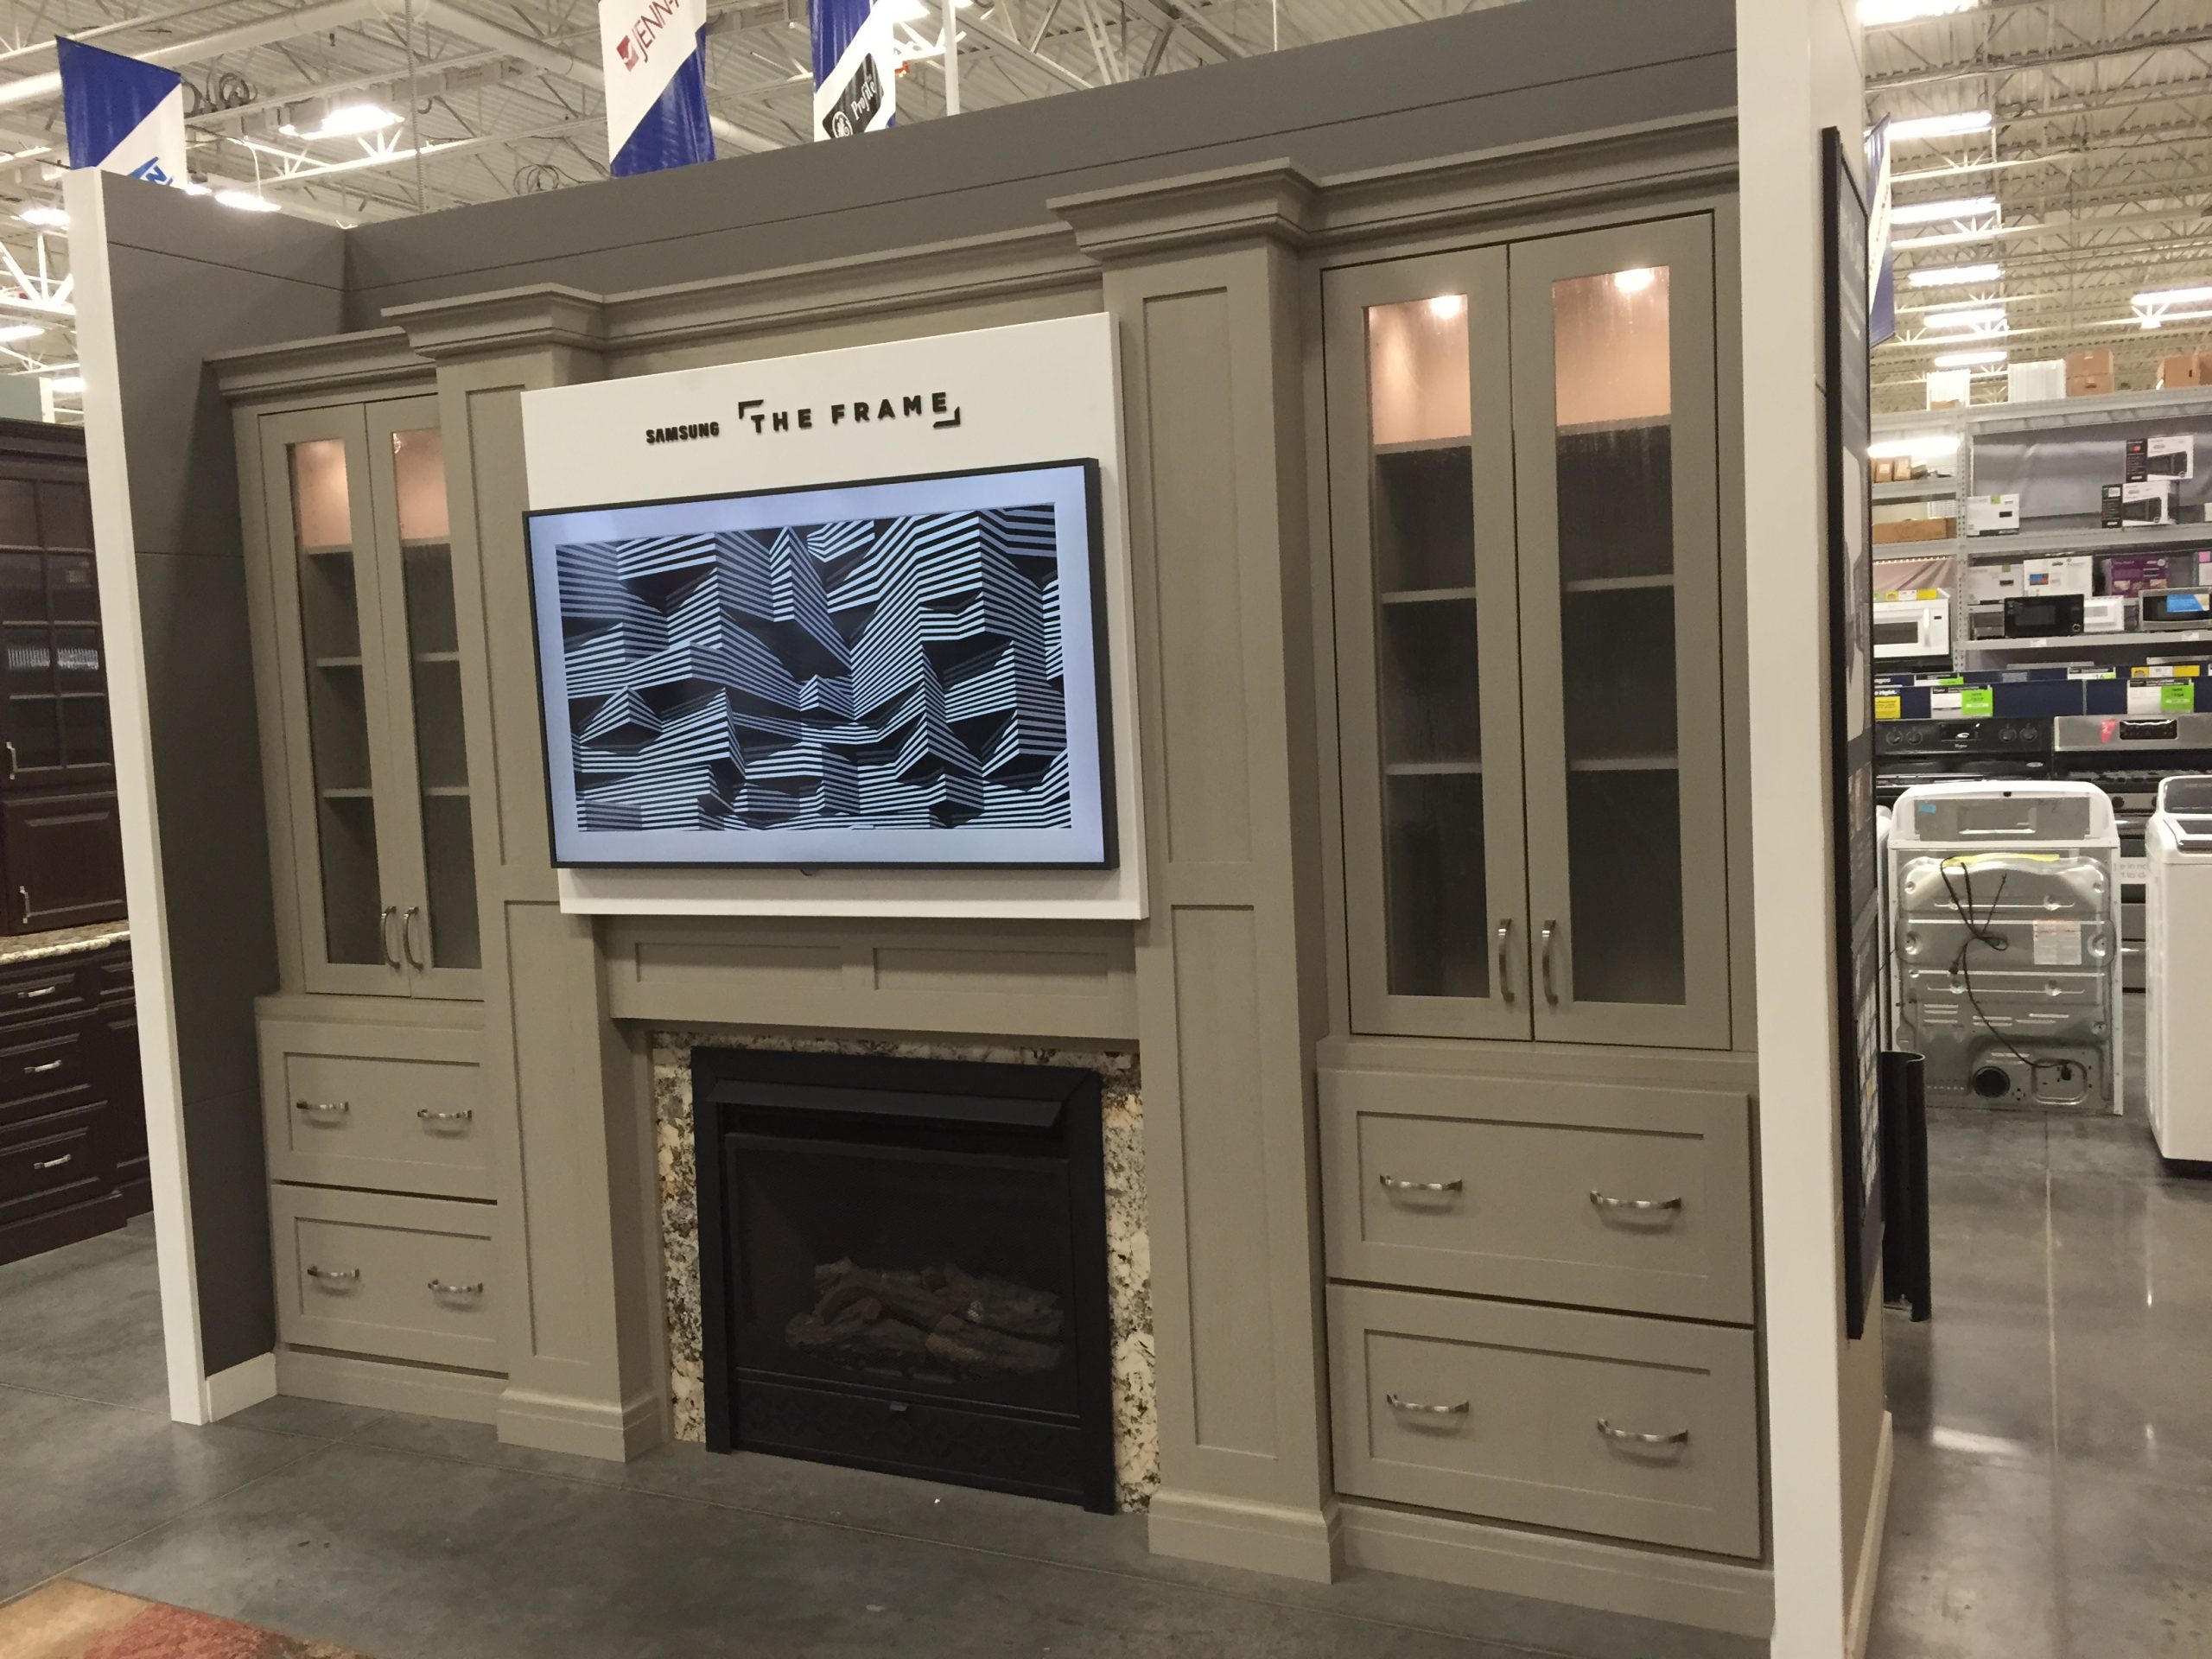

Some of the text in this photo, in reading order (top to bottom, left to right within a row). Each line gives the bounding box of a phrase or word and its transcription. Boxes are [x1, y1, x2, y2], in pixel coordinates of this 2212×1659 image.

[850, 81, 876, 120] Profile
[646, 391, 948, 444] SAMSUNG THE FRAME
